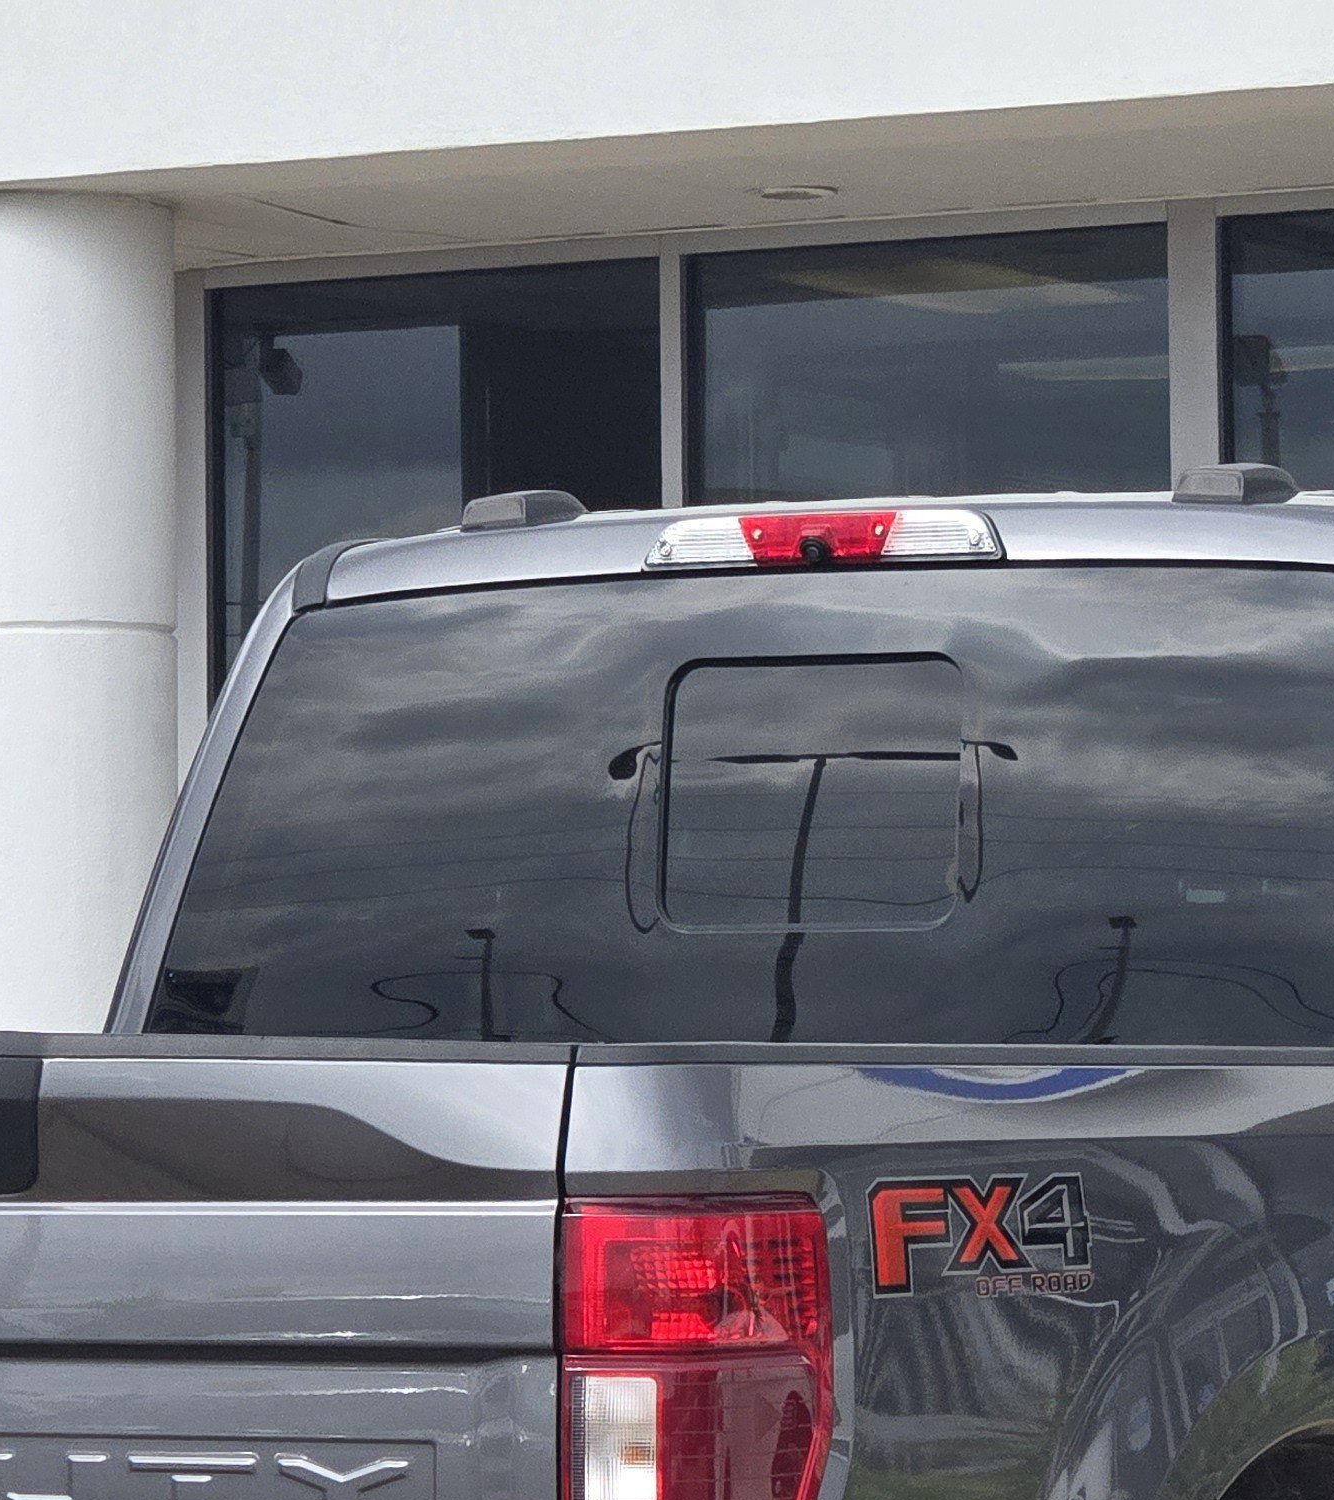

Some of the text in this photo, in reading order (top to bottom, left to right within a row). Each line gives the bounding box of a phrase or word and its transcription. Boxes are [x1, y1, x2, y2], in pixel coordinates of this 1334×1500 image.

[866, 1172, 1093, 1299] FX4
[975, 1271, 1094, 1298] OFF ROAD
